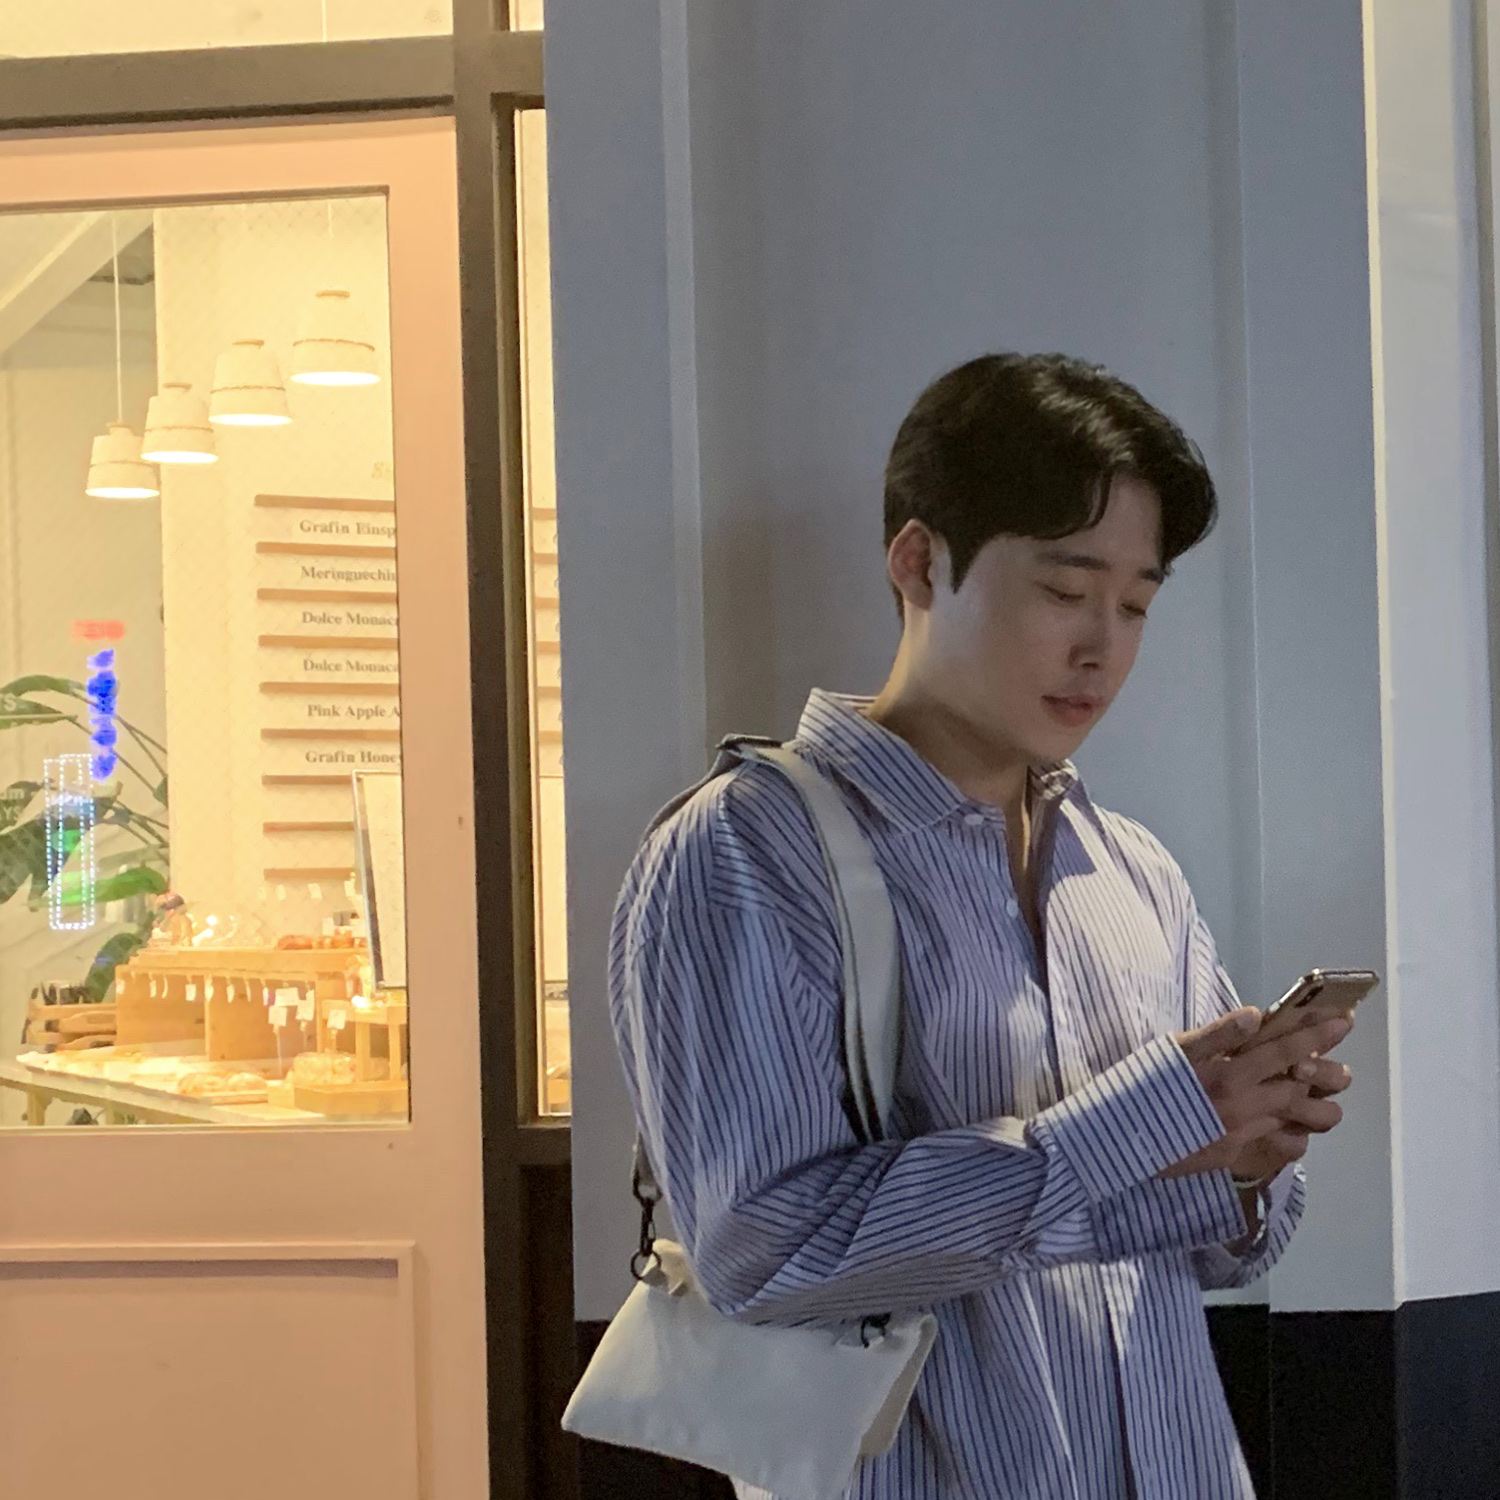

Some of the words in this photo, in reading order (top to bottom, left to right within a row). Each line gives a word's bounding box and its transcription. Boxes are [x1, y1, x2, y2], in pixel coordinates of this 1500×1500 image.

[302, 611, 342, 625] Dolce
[303, 658, 342, 672] Dolce
[307, 704, 341, 717] Pink
[345, 705, 386, 720] Apple
